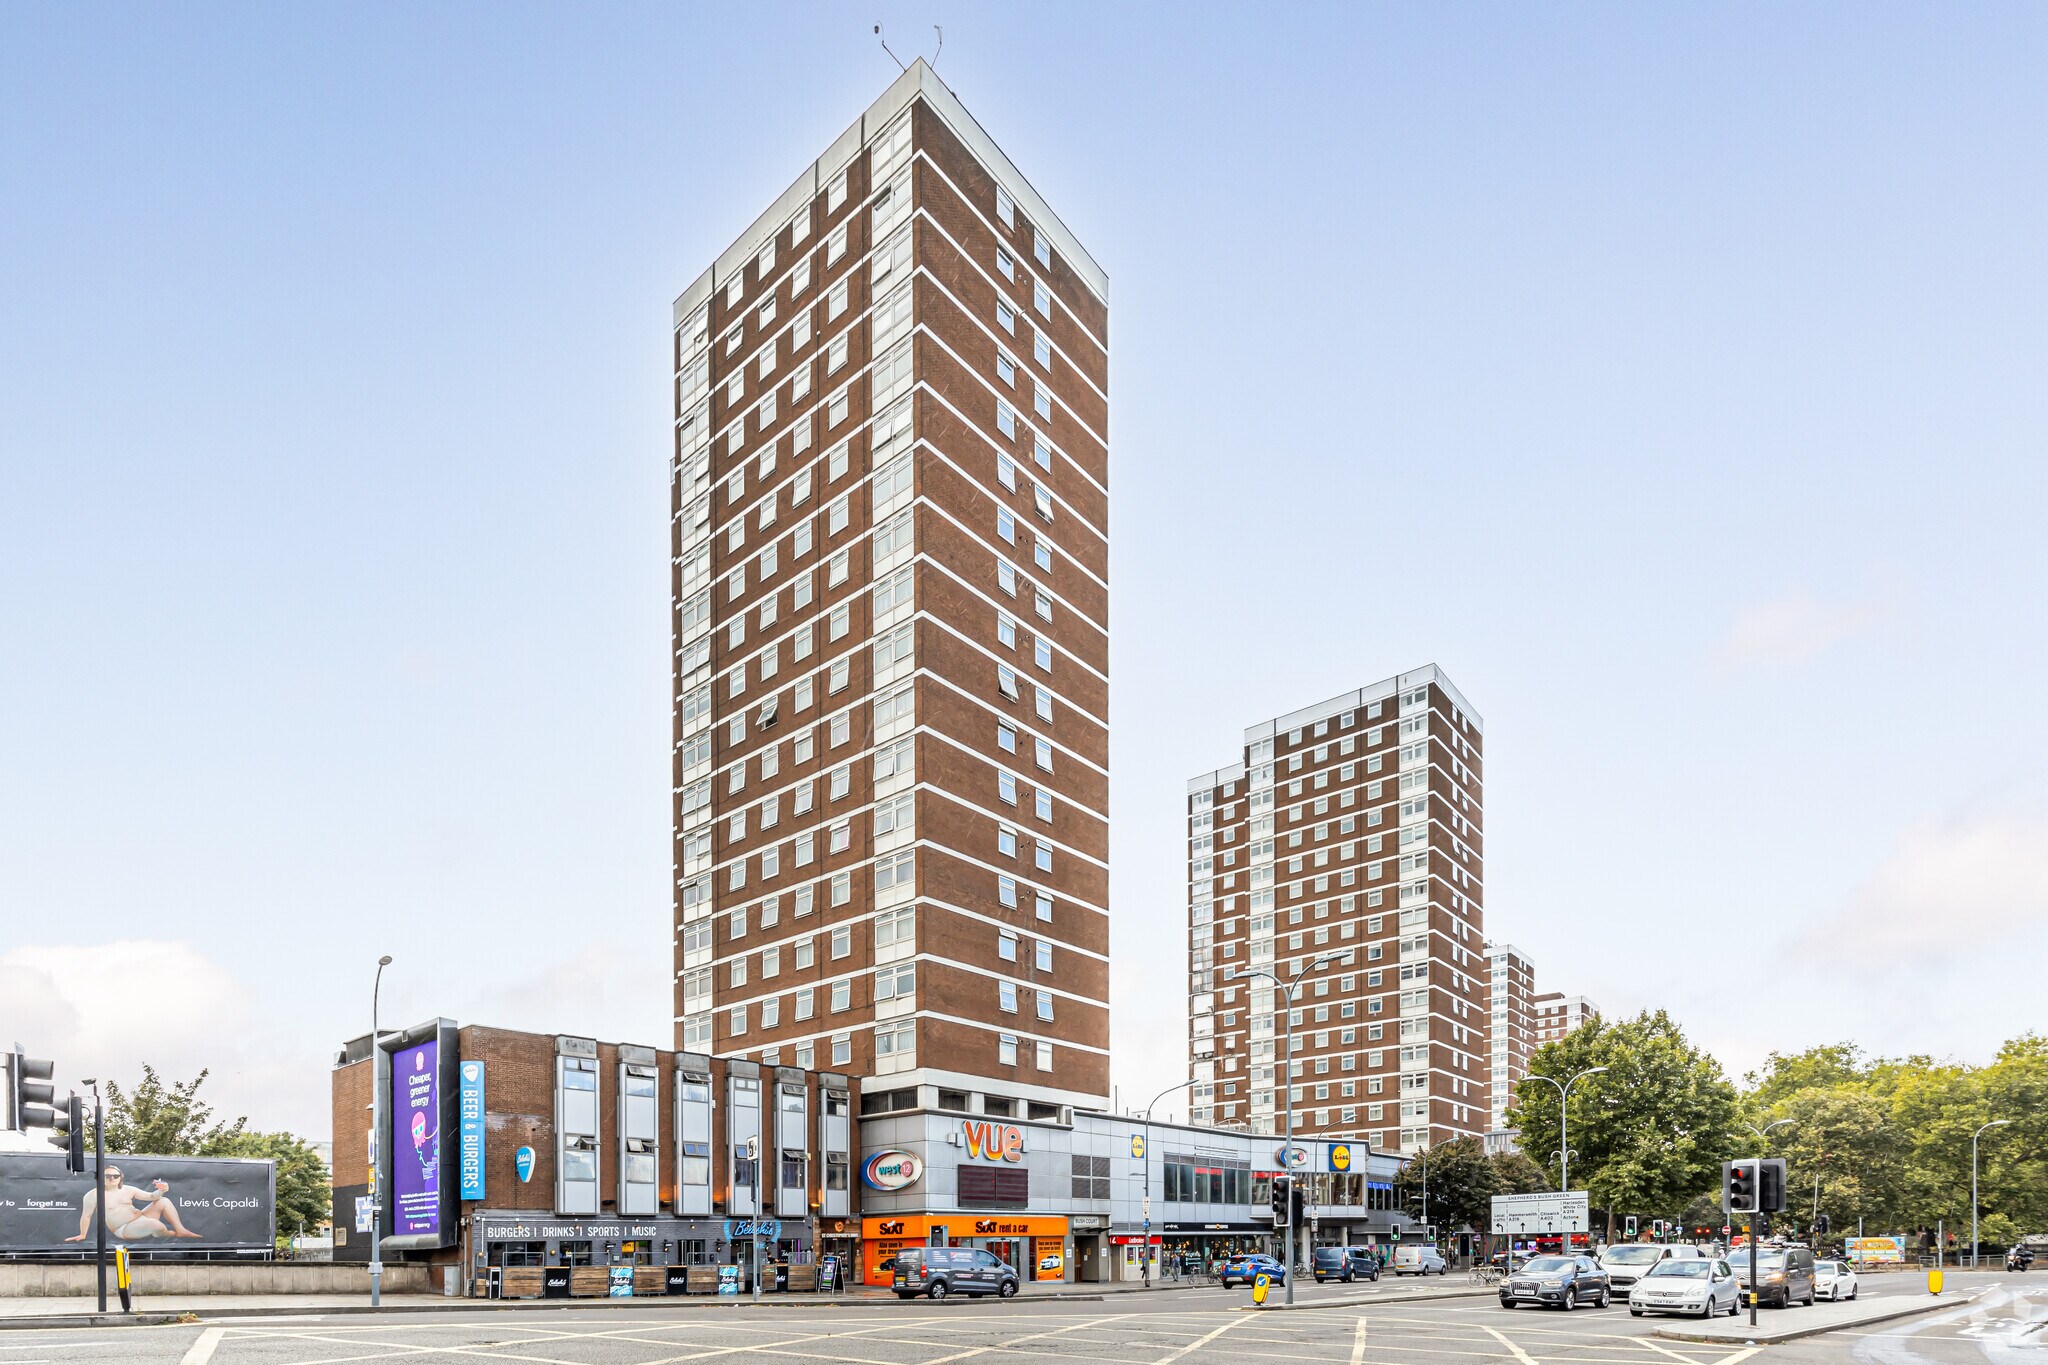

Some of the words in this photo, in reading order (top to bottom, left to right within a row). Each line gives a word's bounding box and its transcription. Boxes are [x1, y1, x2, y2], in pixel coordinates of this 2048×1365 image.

[409, 1073, 431, 1085] Cheaper,
[410, 1085, 430, 1098] greener
[411, 1096, 429, 1107] energy
[463, 1090, 478, 1119] BEER
[463, 1135, 479, 1188] BURGERS
[27, 1199, 53, 1209] forget
[179, 1197, 210, 1207] Lewis
[213, 1197, 259, 1210] Capaldi
[487, 1227, 530, 1238] BURGERS
[543, 1226, 574, 1237] DRINKS
[588, 1226, 620, 1236] SPORTS
[632, 1226, 657, 1236] MUSIC
[999, 1223, 1012, 1233] rent
[1018, 1224, 1028, 1233] car
